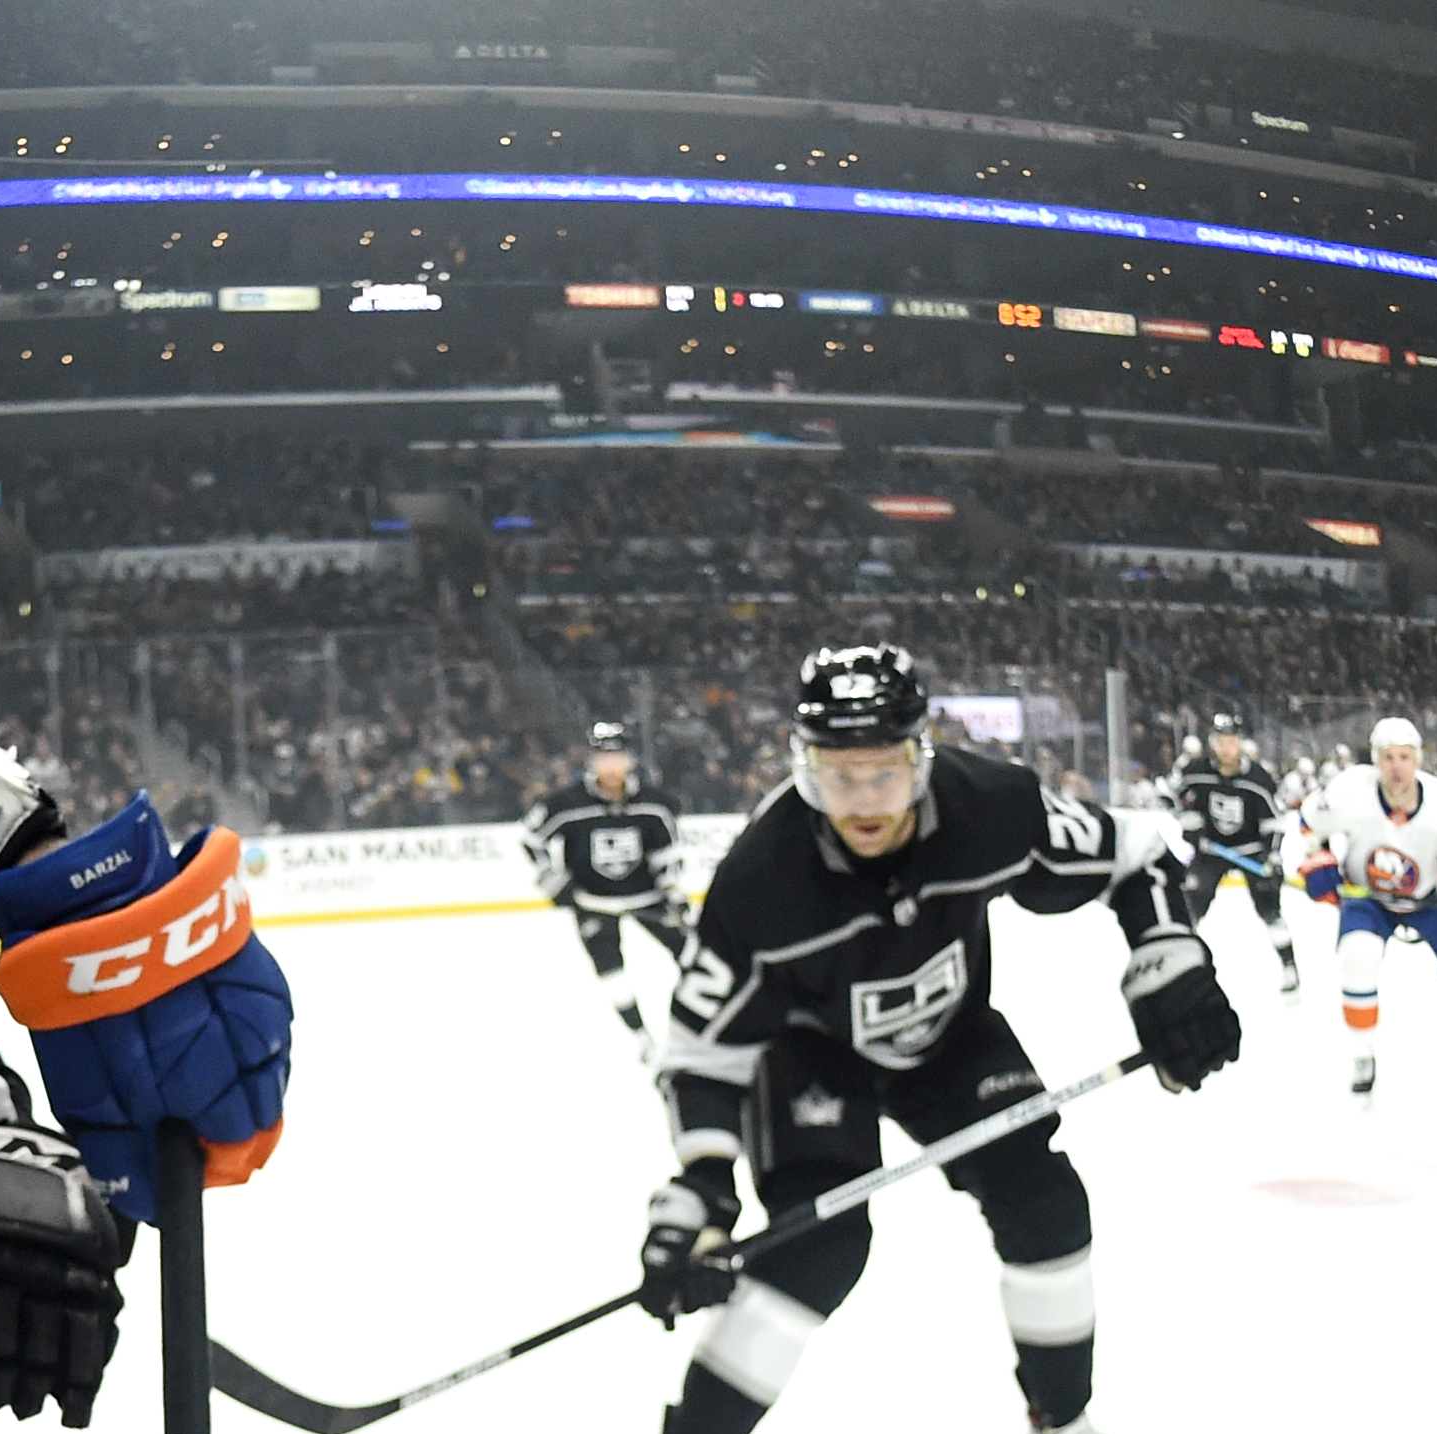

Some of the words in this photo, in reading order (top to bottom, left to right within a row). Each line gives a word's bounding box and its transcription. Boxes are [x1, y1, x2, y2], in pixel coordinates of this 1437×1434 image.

[69, 847, 133, 890] BARZAL
[282, 843, 348, 869] SAN
[363, 835, 506, 864] MANUEL
